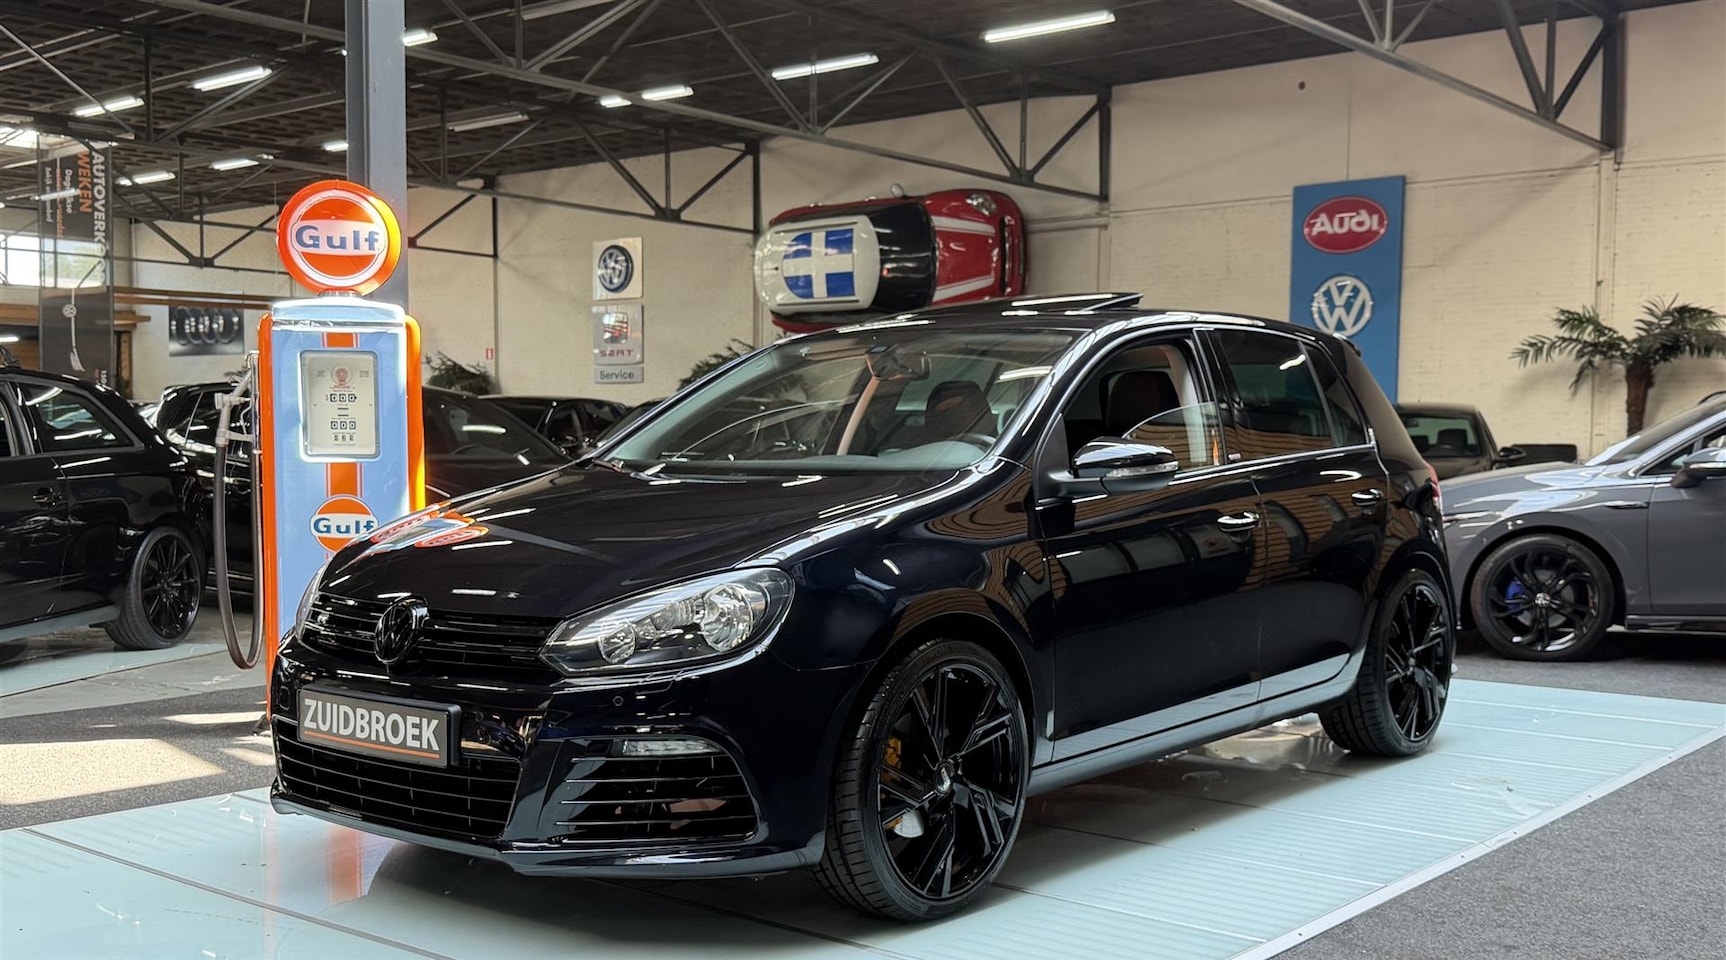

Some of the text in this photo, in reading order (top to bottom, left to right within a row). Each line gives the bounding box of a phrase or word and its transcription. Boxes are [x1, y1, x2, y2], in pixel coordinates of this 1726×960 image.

[77, 151, 92, 213] WEKEN
[295, 224, 380, 251] Gulf
[599, 348, 634, 358] SEAT
[599, 370, 635, 380] Service
[313, 517, 375, 535] Gulf
[303, 698, 441, 751] ZUIDBROEK
